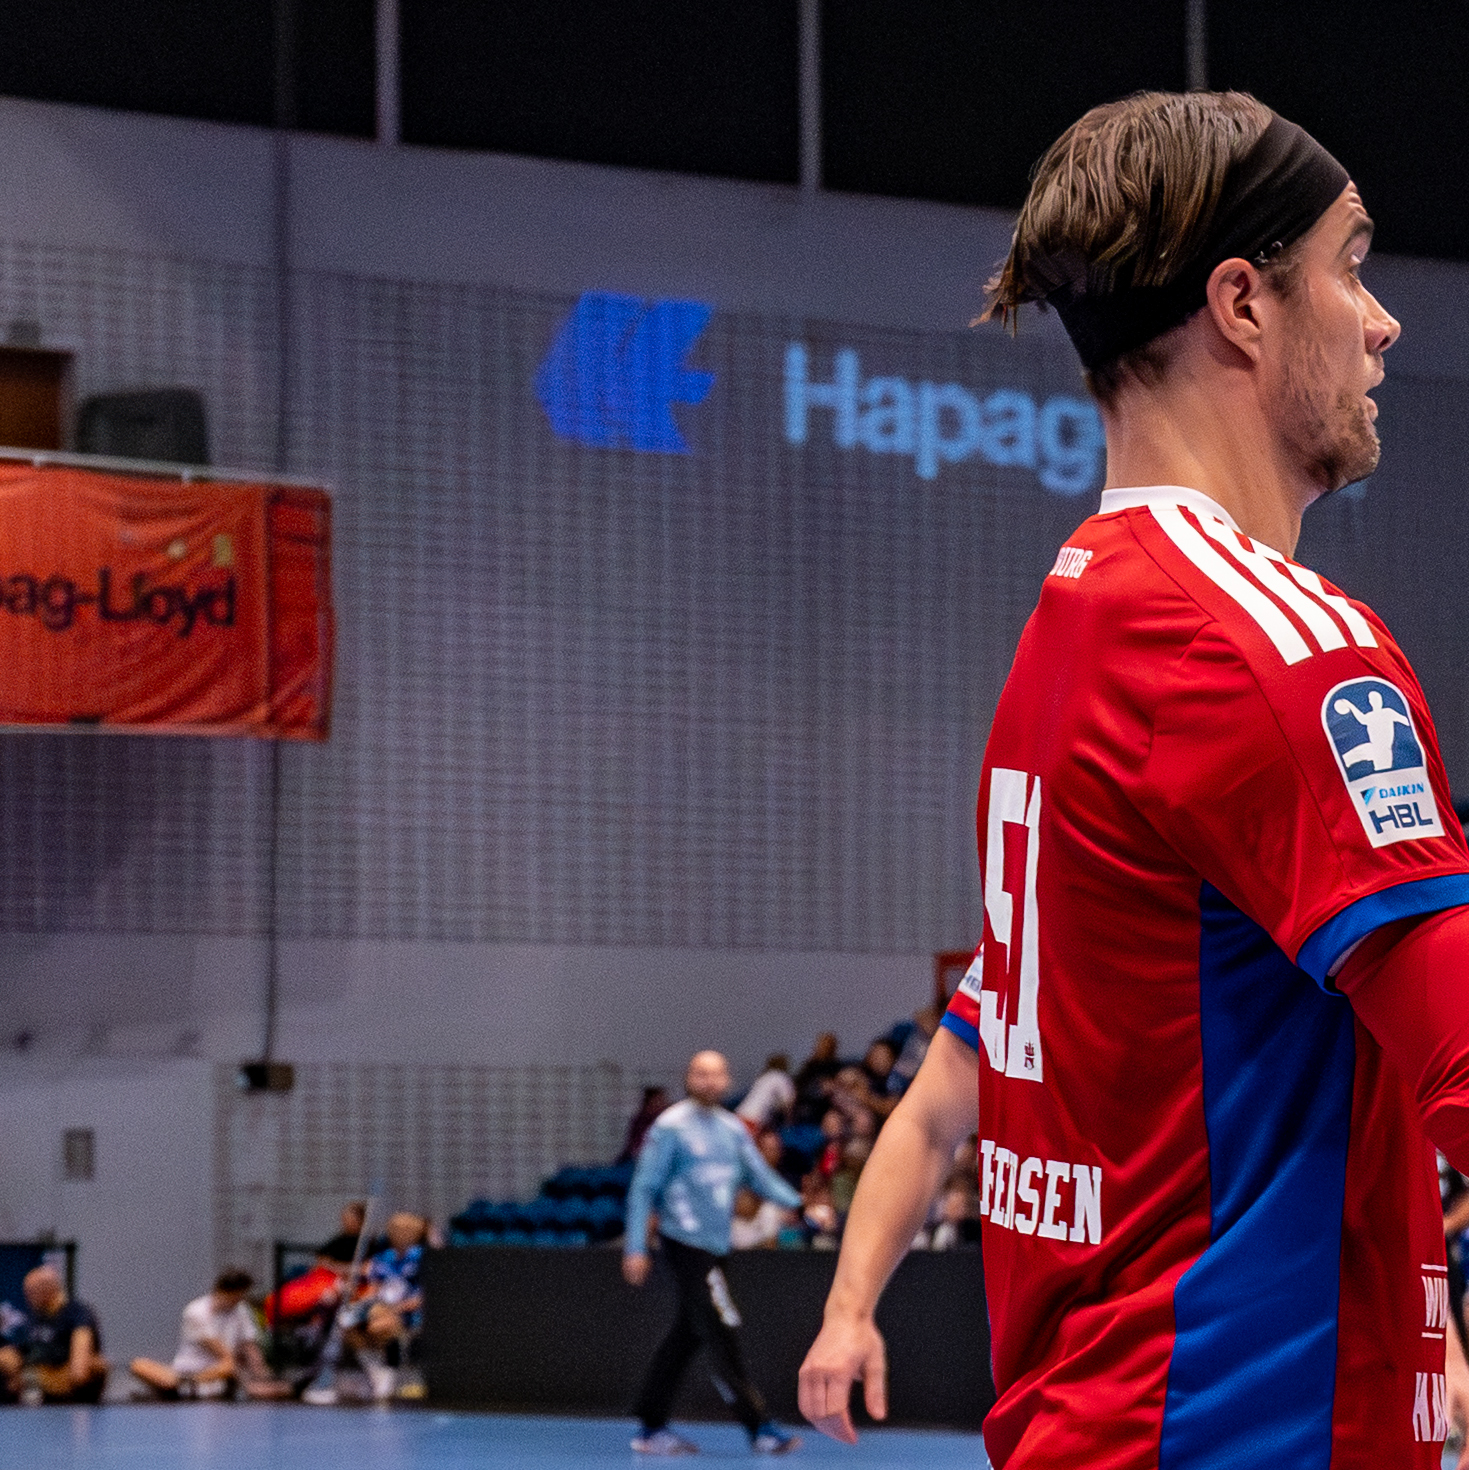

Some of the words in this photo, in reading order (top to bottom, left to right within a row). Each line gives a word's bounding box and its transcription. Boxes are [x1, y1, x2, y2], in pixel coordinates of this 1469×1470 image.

[0, 567, 237, 639] ag-Lloyd
[1379, 782, 1424, 799] DAIKIN
[1368, 801, 1434, 835] HBL
